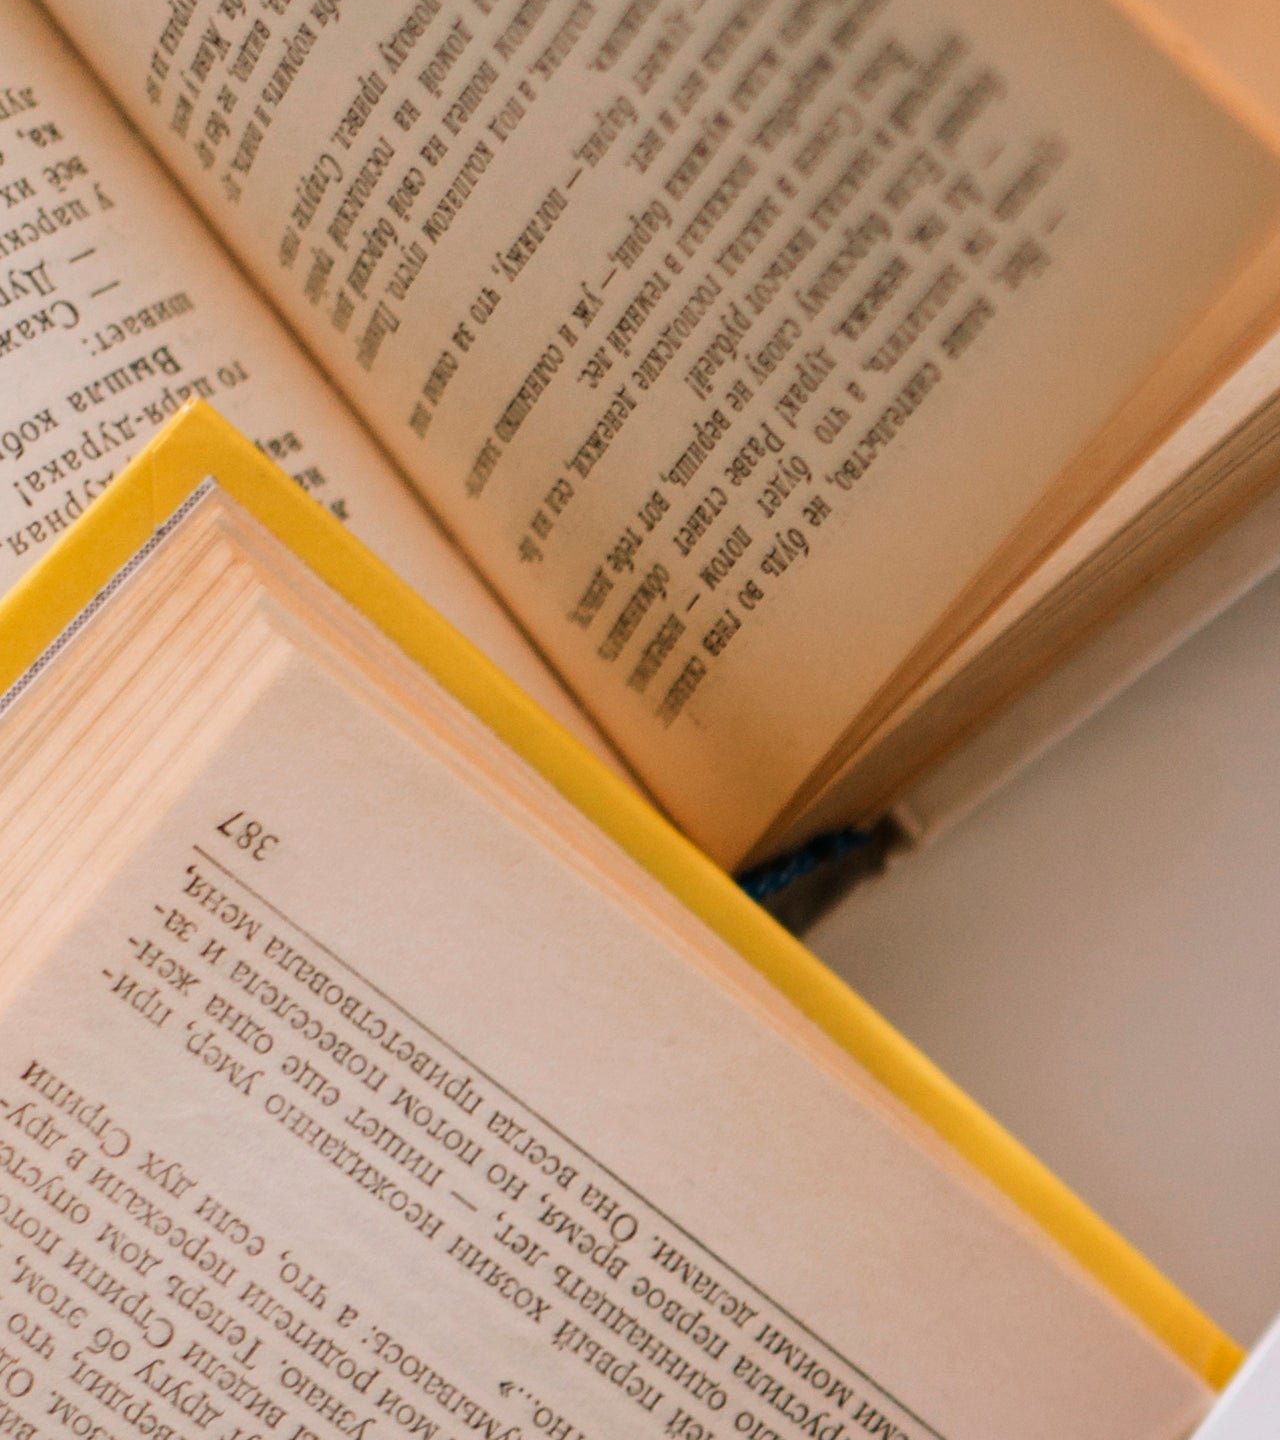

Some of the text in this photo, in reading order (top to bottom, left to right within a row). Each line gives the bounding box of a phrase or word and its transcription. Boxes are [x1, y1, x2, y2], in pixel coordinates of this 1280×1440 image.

[64, 343, 184, 414] Вышла
[213, 809, 281, 863] 387
[180, 863, 485, 1117] приветствовала меня,
[183, 1019, 266, 1098] умер,
[262, 1092, 447, 1241] неожиданно
[443, 1233, 553, 1325] хозяин
[549, 1317, 666, 1414] первый
